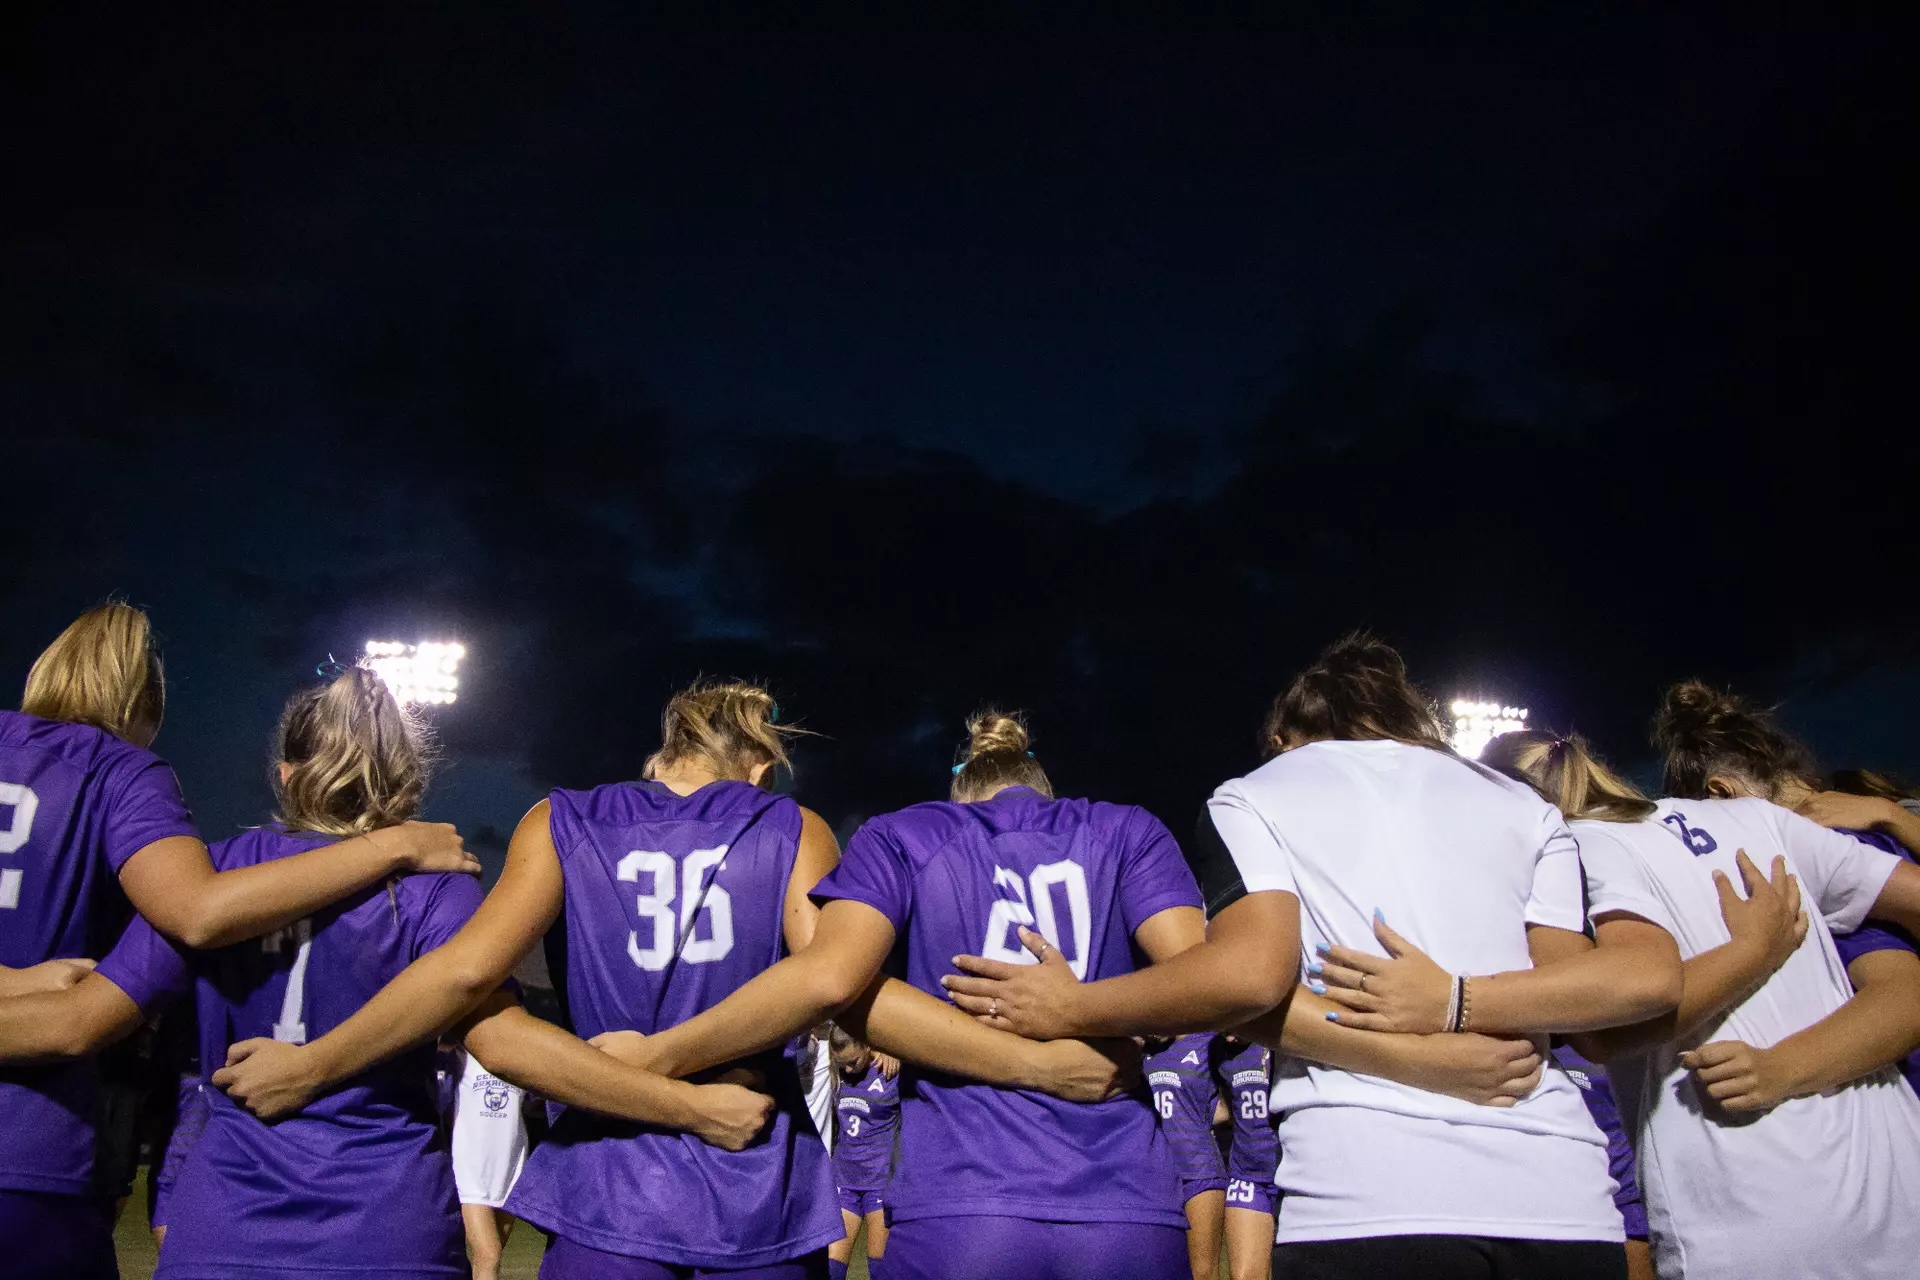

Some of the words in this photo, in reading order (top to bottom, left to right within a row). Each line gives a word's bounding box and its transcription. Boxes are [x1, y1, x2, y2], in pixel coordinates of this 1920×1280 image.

[617, 844, 734, 971] 36
[982, 859, 1091, 980] 20
[1241, 1089, 1268, 1118] 29
[846, 1115, 860, 1137] 3
[1226, 1177, 1255, 1202] 29
